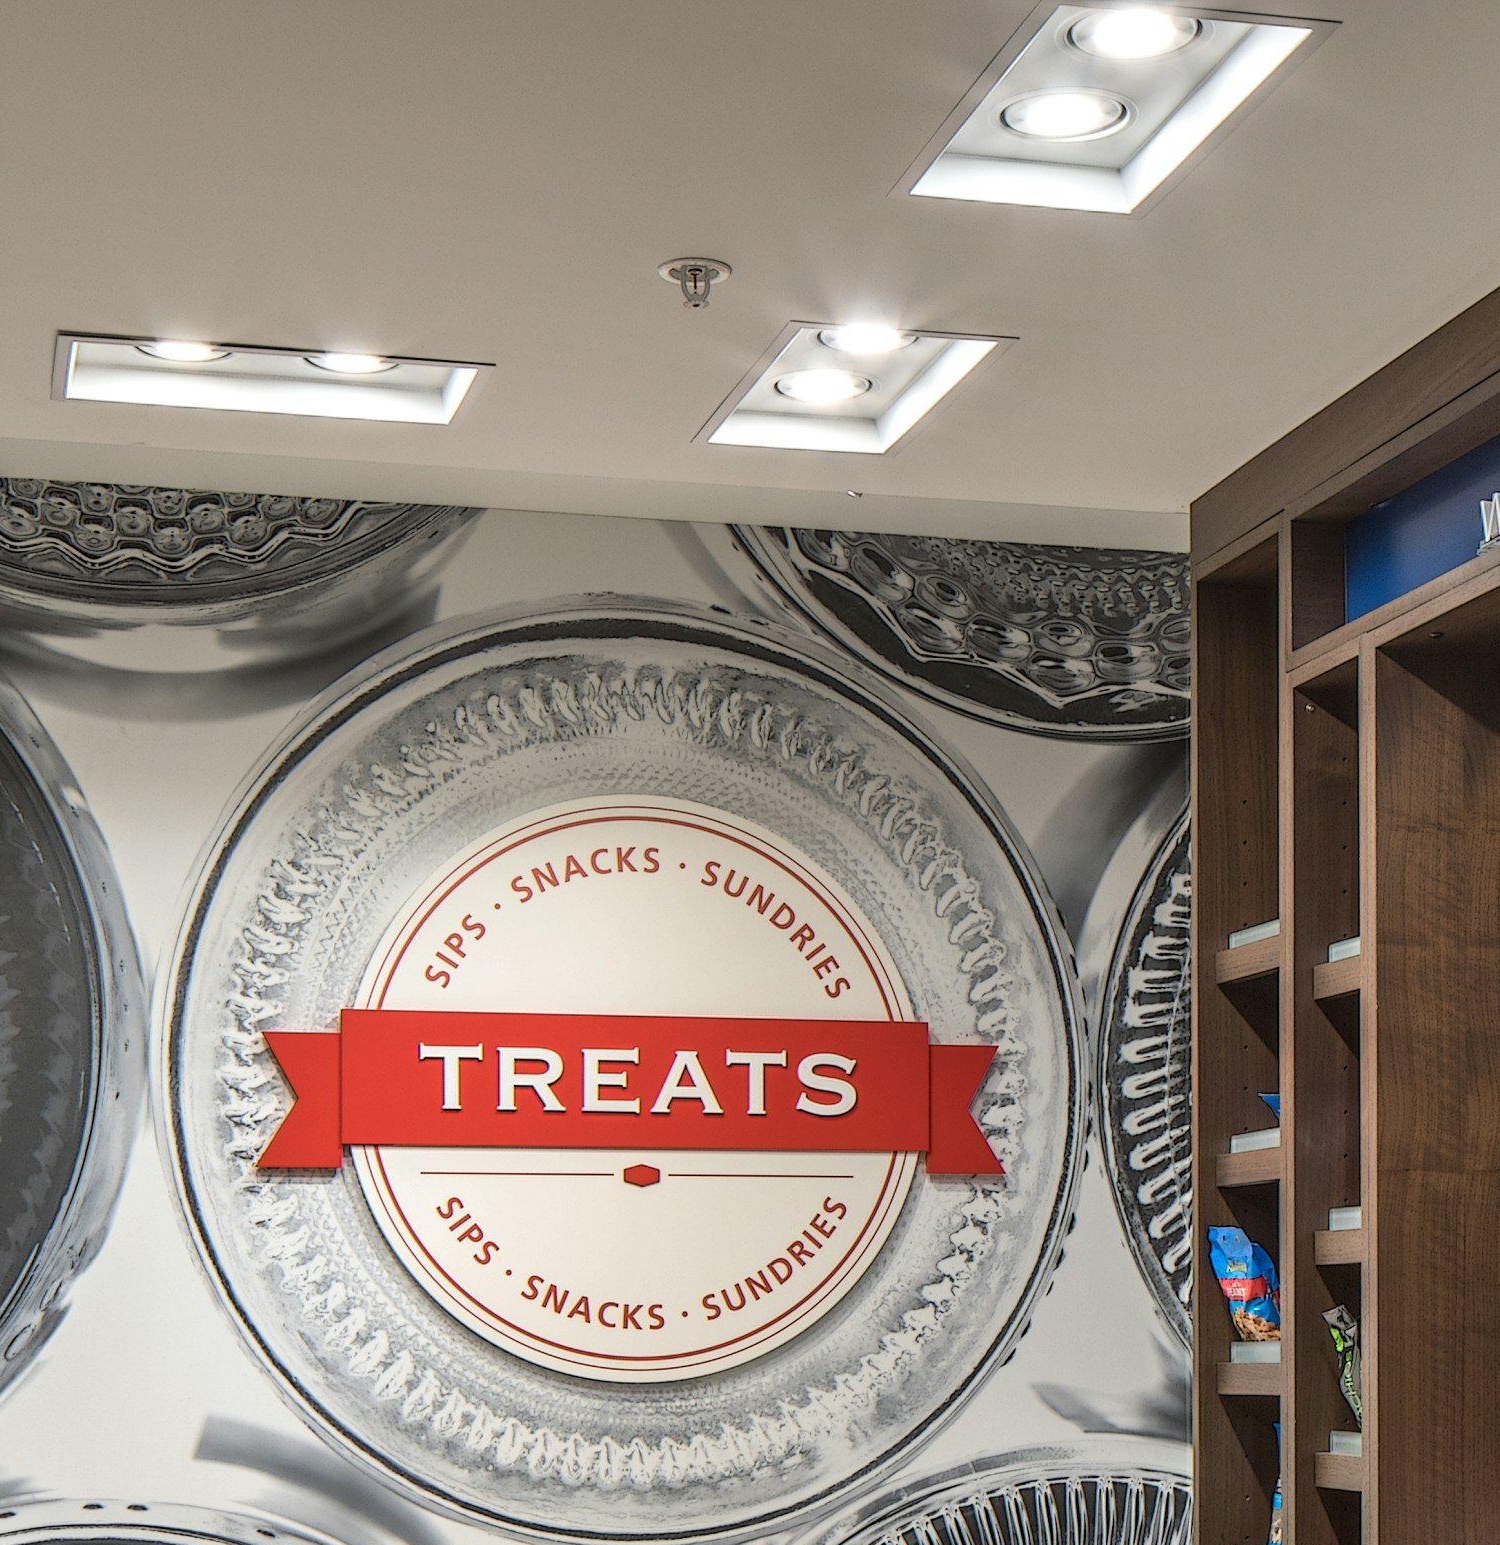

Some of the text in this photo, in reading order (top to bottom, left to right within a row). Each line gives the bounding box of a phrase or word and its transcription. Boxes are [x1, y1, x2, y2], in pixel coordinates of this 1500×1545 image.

[424, 847, 849, 999] SIPS SNACKS SUNDRIES
[419, 1042, 857, 1117] TREATS
[437, 1196, 846, 1331] SIPS SNACKS SUNDRIES
